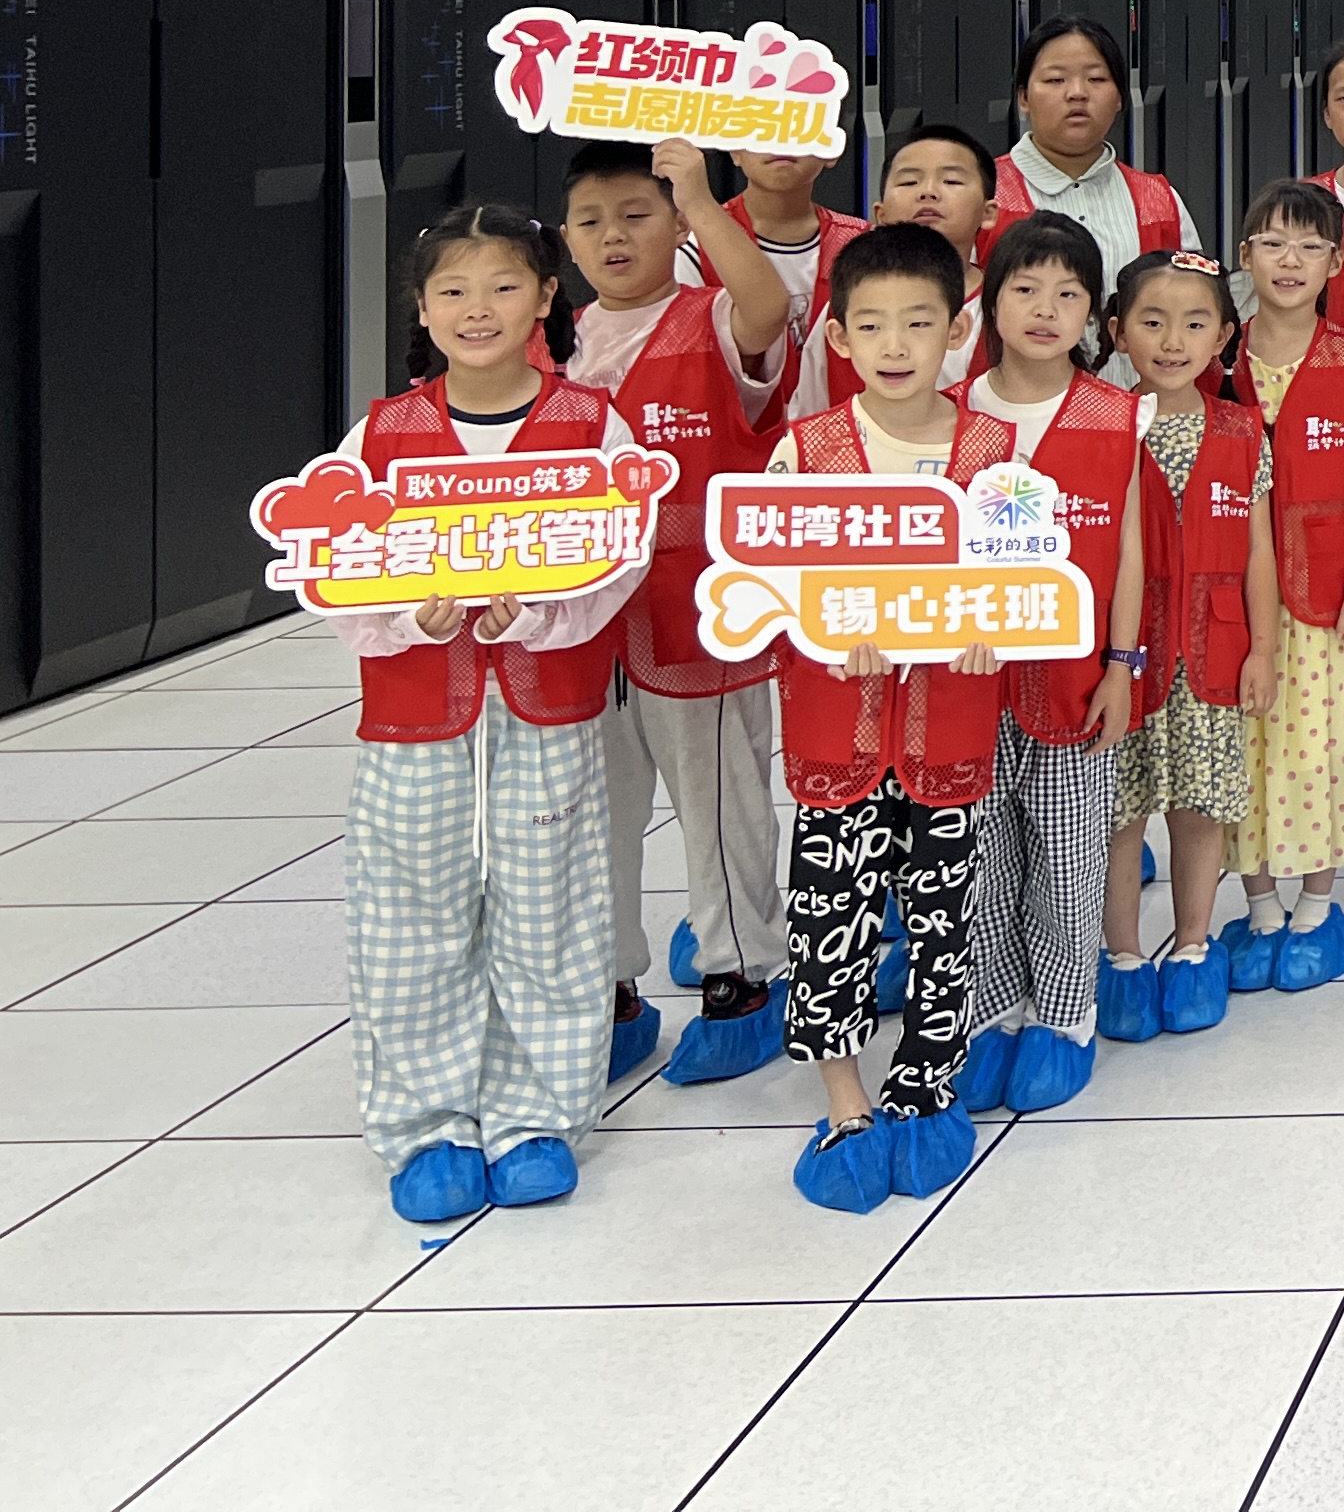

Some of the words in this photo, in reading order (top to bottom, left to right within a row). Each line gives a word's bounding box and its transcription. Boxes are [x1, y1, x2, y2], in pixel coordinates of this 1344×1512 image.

[24, 35, 38, 96] TAIHU
[574, 32, 738, 87] 红领巾
[24, 104, 38, 164] LIGHT
[565, 82, 833, 147] 志愿服务队
[406, 466, 591, 499] 耿Young筑梦
[276, 505, 642, 583] 工会爱心托管班
[736, 505, 946, 549] 耿湾社区
[966, 536, 1057, 557] 七彩的夏日
[820, 582, 1060, 636] 锡心托班
[532, 811, 564, 826] REAL
